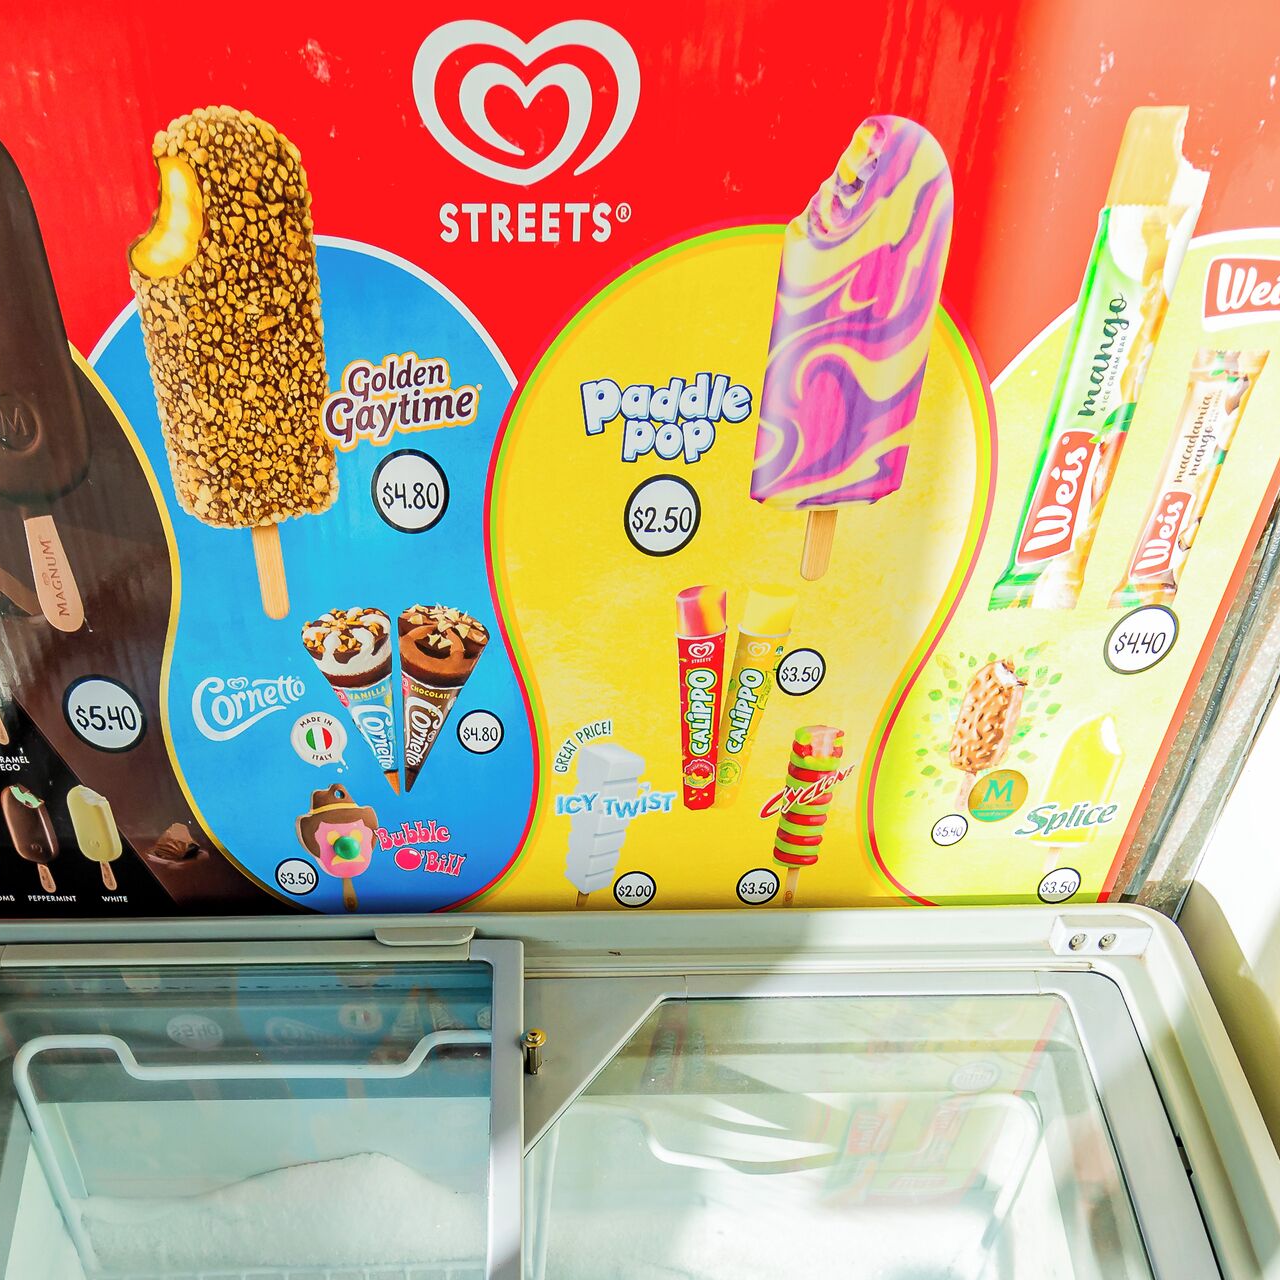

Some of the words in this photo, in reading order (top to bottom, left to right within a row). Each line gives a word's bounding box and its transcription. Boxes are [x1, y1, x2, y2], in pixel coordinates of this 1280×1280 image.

[438, 202, 613, 244] STREETS
[1077, 291, 1130, 417] mango
[347, 358, 446, 402] Golden
[1107, 355, 1121, 387] CREAM
[324, 389, 474, 444] Gaytime
[1173, 393, 1214, 483] macadamia
[1188, 425, 1217, 476] mango
[382, 482, 440, 510] $4.80
[1023, 444, 1089, 553] Weis
[631, 506, 693, 535] $2.50
[1133, 495, 1185, 577] Weis
[37, 538, 71, 617] MAGNUM
[1113, 631, 1167, 655] $4.40
[780, 665, 821, 683] $3.50
[347, 685, 387, 700] VANILLA
[410, 684, 451, 700] CHOCOLATE
[75, 704, 138, 732] $5.40
[191, 674, 306, 743] Cornetto
[299, 716, 321, 728] MADE
[323, 718, 333, 727] IN
[351, 704, 395, 770] Cornetto
[403, 696, 444, 766] Cornetto
[462, 725, 499, 742] $4.80
[312, 753, 333, 761] ITALY
[554, 740, 579, 773] GREAT
[575, 719, 612, 745] PRICE!
[0, 763, 21, 772] EGO
[555, 792, 599, 817] ICY
[982, 779, 1015, 803] M
[935, 825, 963, 838] $5.40
[1014, 803, 1118, 836] Splice
[374, 819, 451, 851] Bubble
[279, 870, 316, 886] $3.50
[617, 883, 652, 898] $2.00
[740, 880, 776, 896] $3.50
[1041, 880, 1076, 895] $3.50
[27, 894, 77, 903] PEPPERMINT
[101, 894, 128, 903] WHITE
